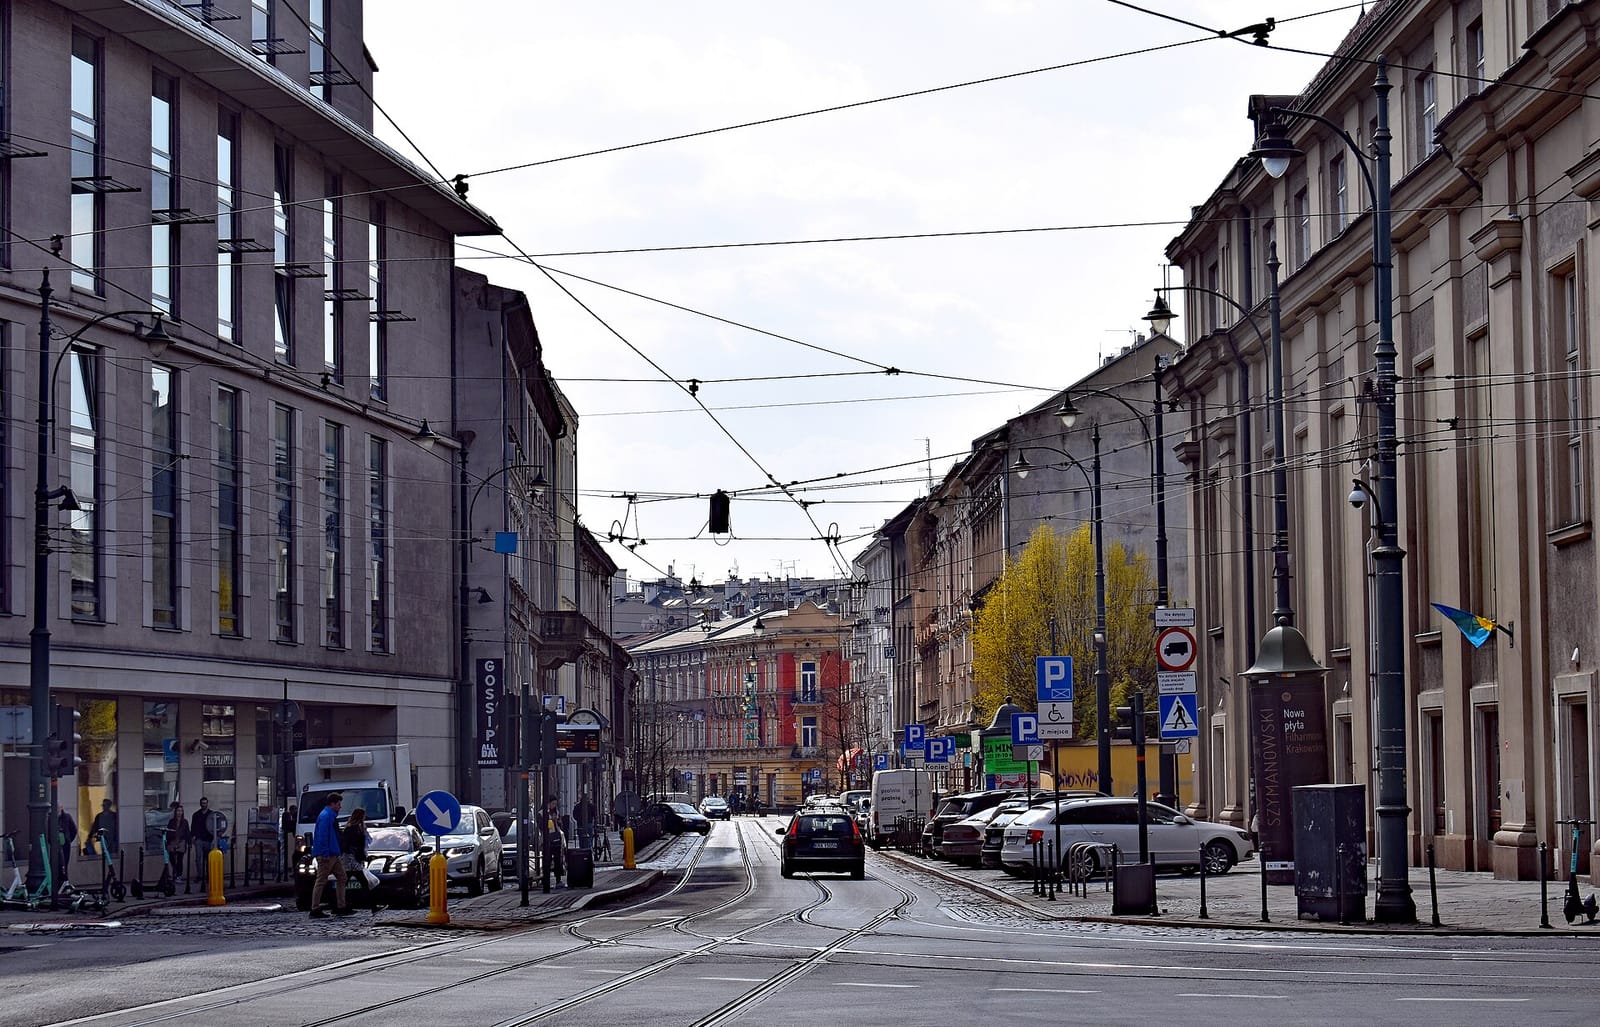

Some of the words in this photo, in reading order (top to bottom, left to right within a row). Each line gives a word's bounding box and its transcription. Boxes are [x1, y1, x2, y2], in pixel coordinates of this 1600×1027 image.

[1044, 660, 1065, 689] P
[484, 660, 496, 741] GOSSIP
[1283, 708, 1305, 719] Nowa
[909, 726, 921, 743] P
[1018, 716, 1037, 742] P
[1284, 720, 1305, 733] płyta
[930, 741, 944, 760] P
[877, 755, 885, 766] P
[925, 763, 949, 771] Koniec
[1260, 708, 1281, 826] SZYMANOWSKI
